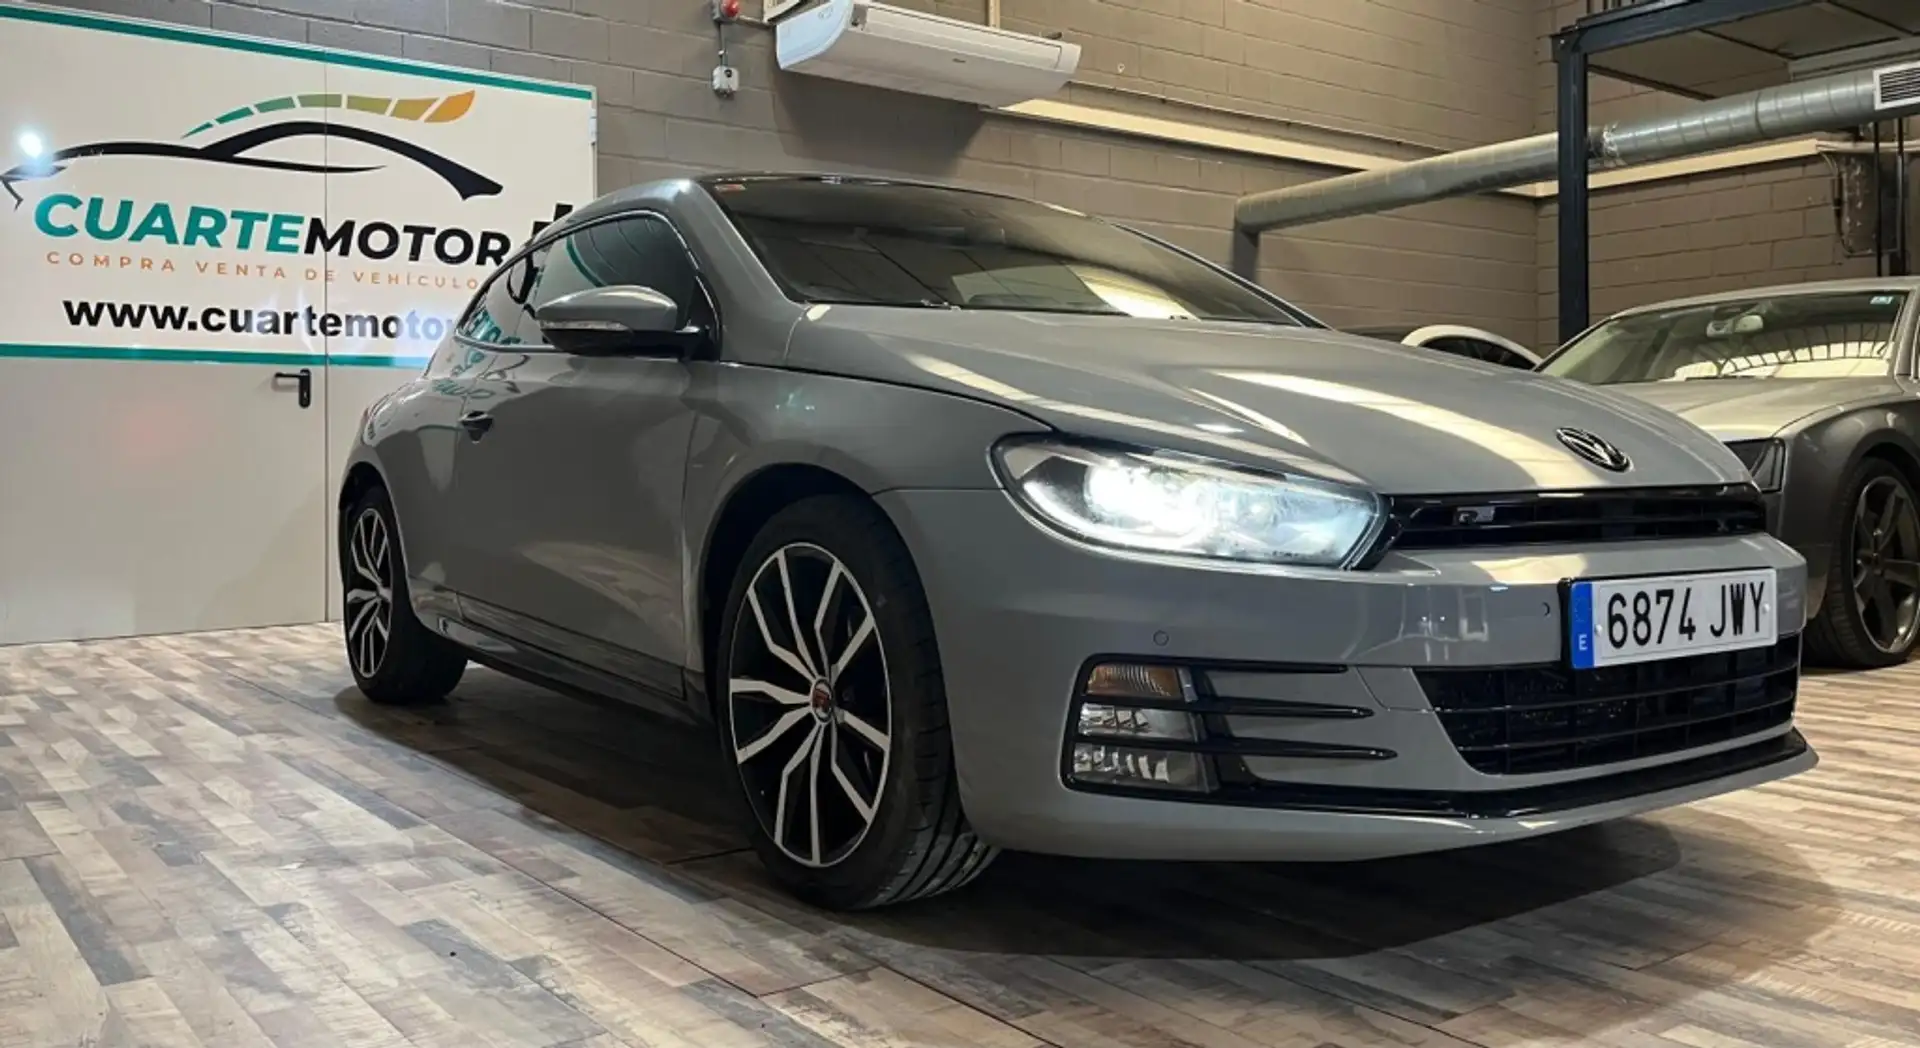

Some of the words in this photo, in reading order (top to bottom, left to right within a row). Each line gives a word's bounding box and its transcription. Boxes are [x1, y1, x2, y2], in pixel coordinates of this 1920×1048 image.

[34, 193, 511, 266] CUARTEMOTOR
[46, 251, 176, 273] COMPRA
[195, 260, 286, 280] VENTA
[305, 268, 335, 284] DE
[1607, 587, 1697, 650] 6874
[1709, 581, 1766, 638] JWY
[1578, 634, 1588, 651] E
